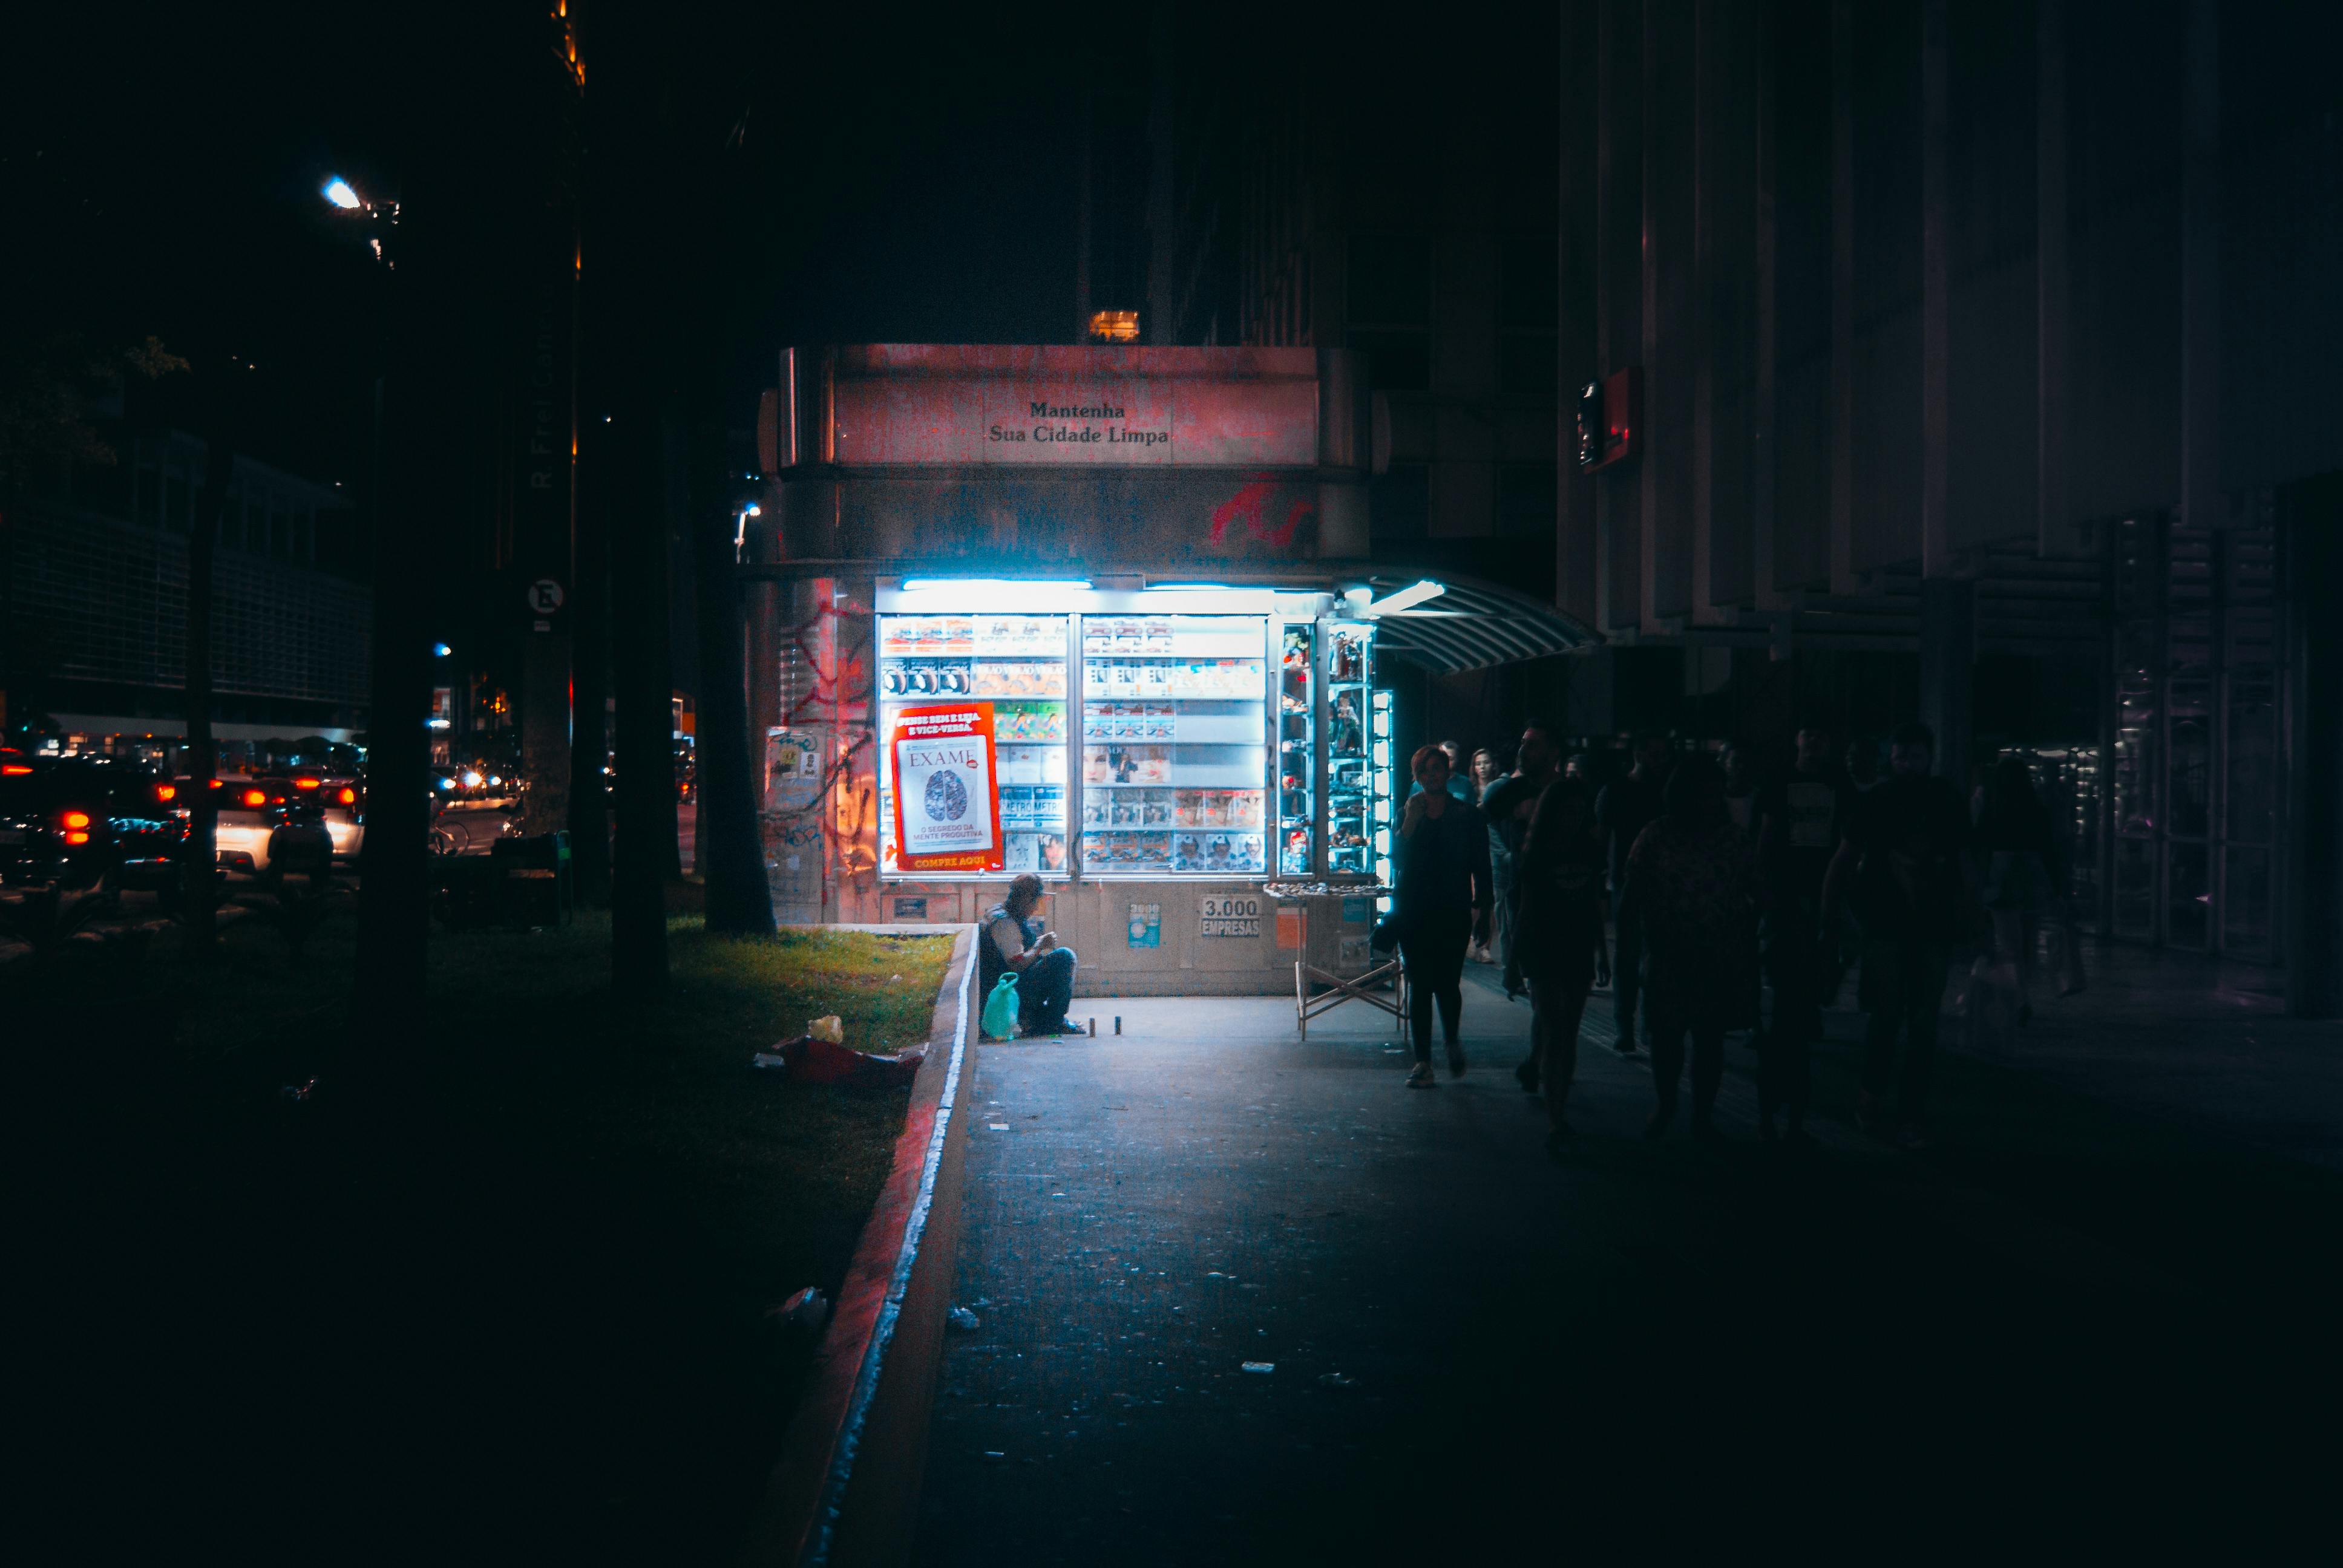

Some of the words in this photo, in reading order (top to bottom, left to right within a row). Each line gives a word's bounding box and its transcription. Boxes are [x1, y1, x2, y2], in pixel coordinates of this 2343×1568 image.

[1031, 402, 1124, 418] Mantenha
[989, 425, 1026, 442] Sua
[1033, 426, 1101, 442] Cidade
[1108, 426, 1168, 446] Limpa
[910, 749, 975, 767] EXAME
[928, 825, 962, 833] SEGREDO
[941, 831, 983, 839] PRODUTIVA
[914, 858, 957, 868] COMPRE
[960, 856, 986, 865] AQUI
[1205, 900, 1257, 916] 3.000
[1202, 920, 1260, 936] EMPRESAS
